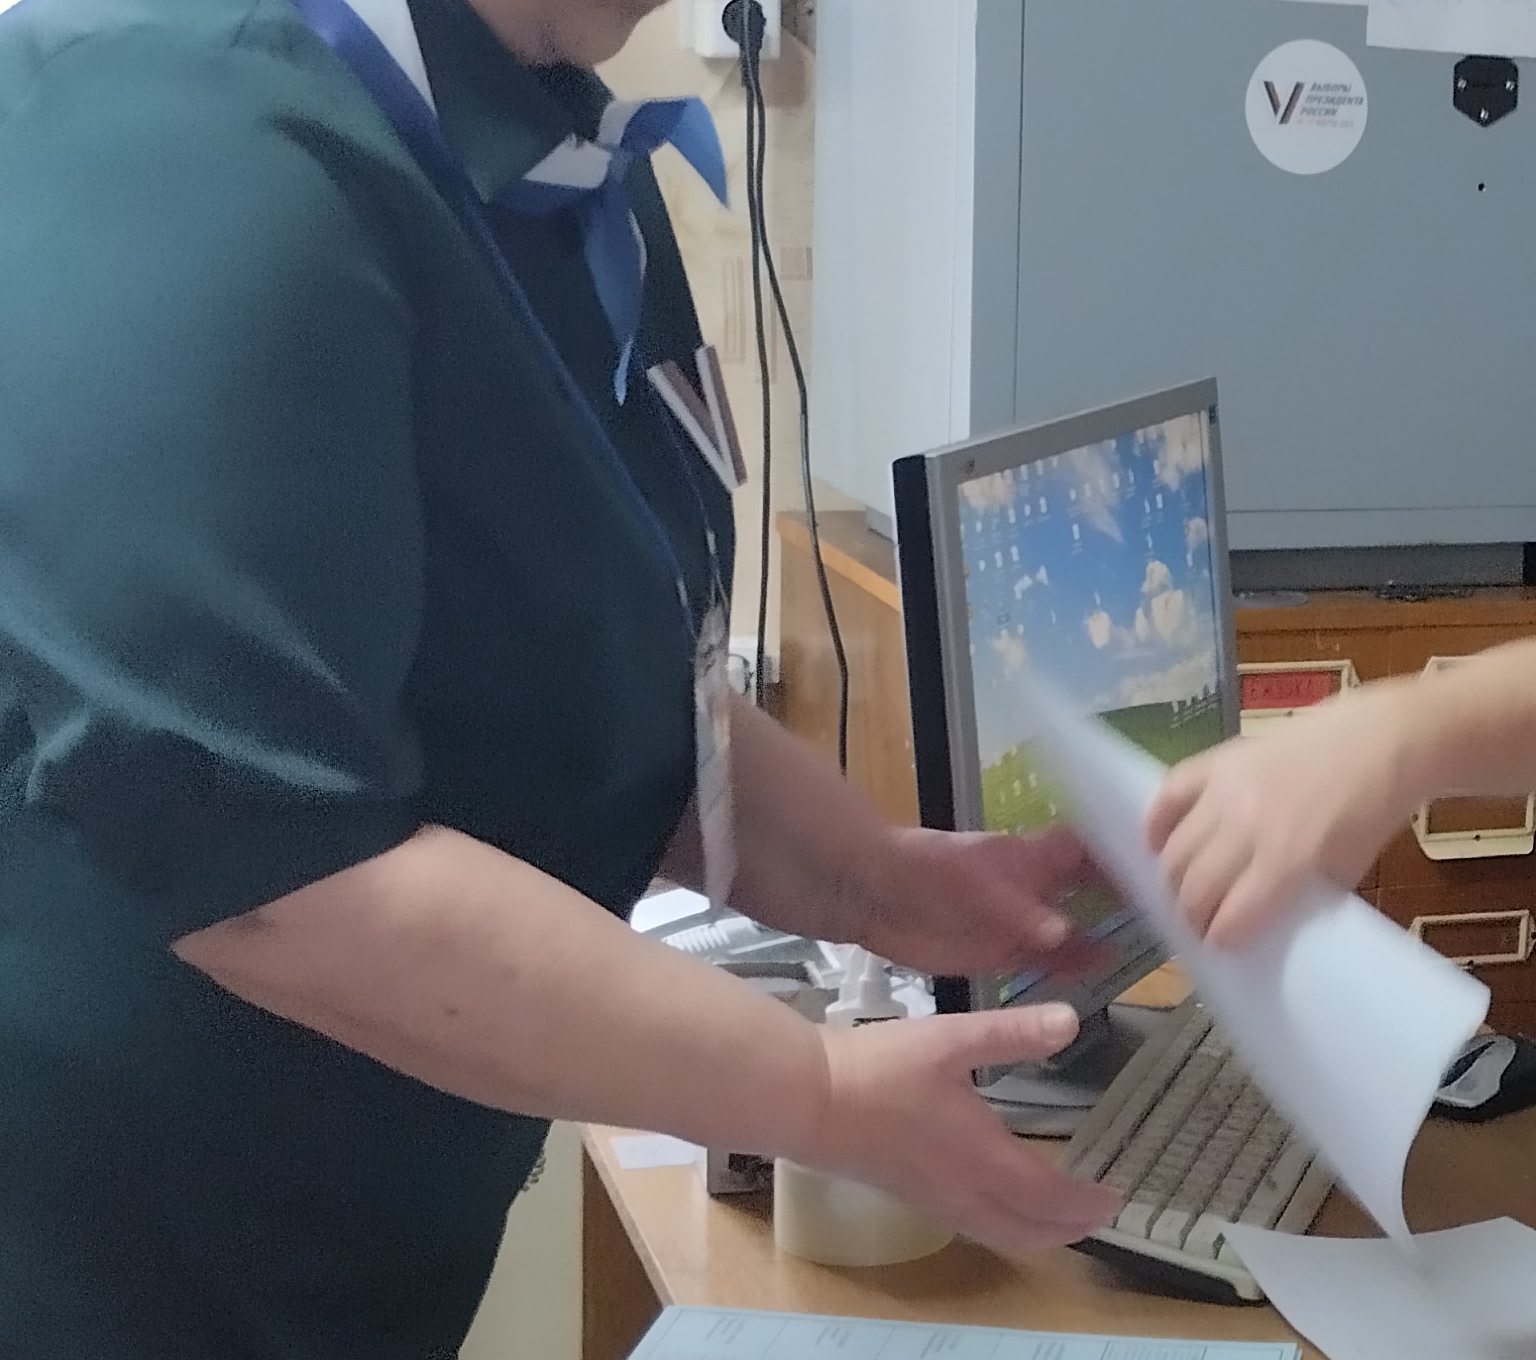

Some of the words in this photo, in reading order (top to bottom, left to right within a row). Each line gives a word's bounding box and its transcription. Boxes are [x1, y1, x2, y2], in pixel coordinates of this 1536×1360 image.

[1310, 82, 1352, 93] ВЫБОРЫ
[1305, 94, 1364, 106] ПРЕЗИДЕНТА
[1301, 106, 1340, 117] РОССИИ
